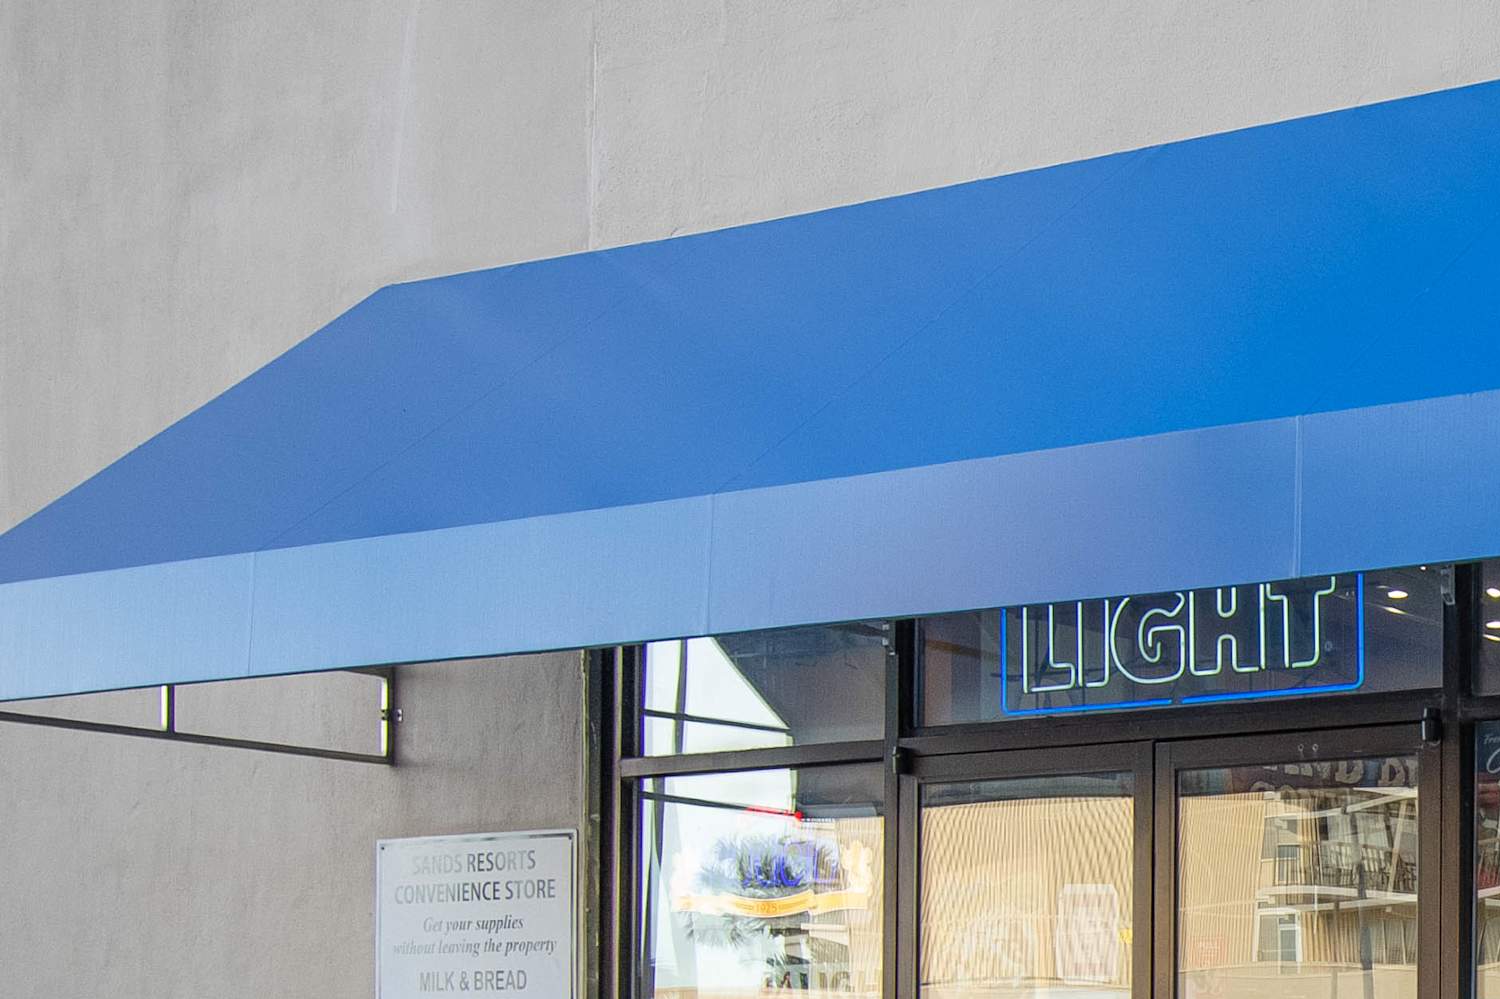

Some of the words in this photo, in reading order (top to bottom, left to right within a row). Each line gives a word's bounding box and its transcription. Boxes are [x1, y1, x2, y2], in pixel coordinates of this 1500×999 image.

[1022, 576, 1336, 693] LIGHT
[412, 854, 463, 876] SANDS
[467, 850, 537, 873] RESORTS
[394, 881, 501, 905] CONVENIENCE
[505, 879, 556, 901] STORE
[423, 916, 443, 932] Get
[444, 918, 473, 936] your
[475, 914, 524, 934] supplies
[393, 940, 436, 954] without
[438, 940, 480, 957] leaving
[484, 938, 503, 953] the
[503, 940, 557, 957] property
[419, 971, 456, 992] MILK
[459, 971, 470, 991] &
[474, 970, 528, 991] BREAD
